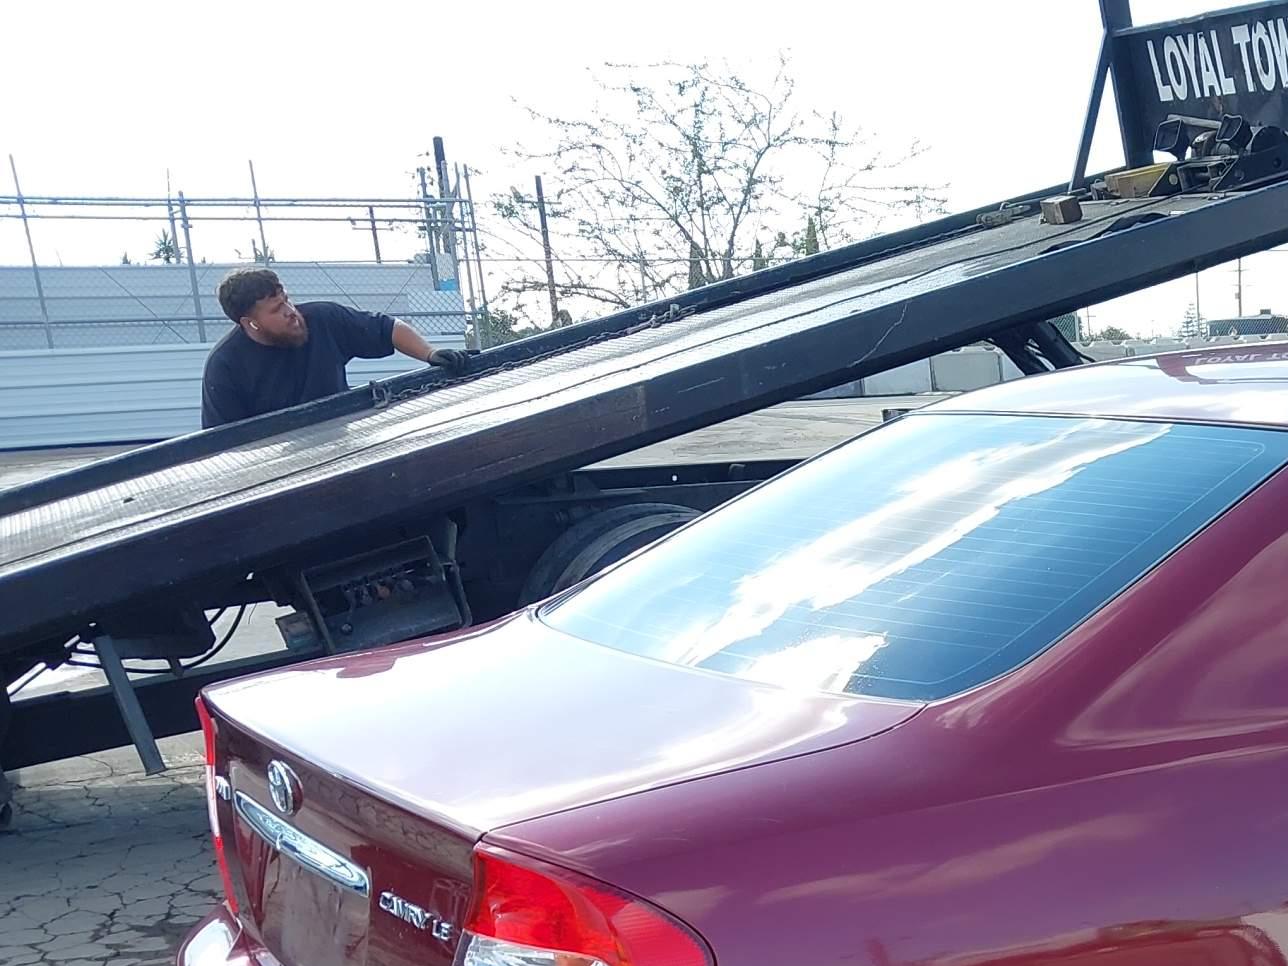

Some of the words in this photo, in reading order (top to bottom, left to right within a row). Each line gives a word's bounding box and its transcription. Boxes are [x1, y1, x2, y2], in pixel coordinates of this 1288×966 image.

[1146, 29, 1236, 102] LOYAL
[379, 891, 432, 930] CAMRY
[432, 919, 454, 942] LE
